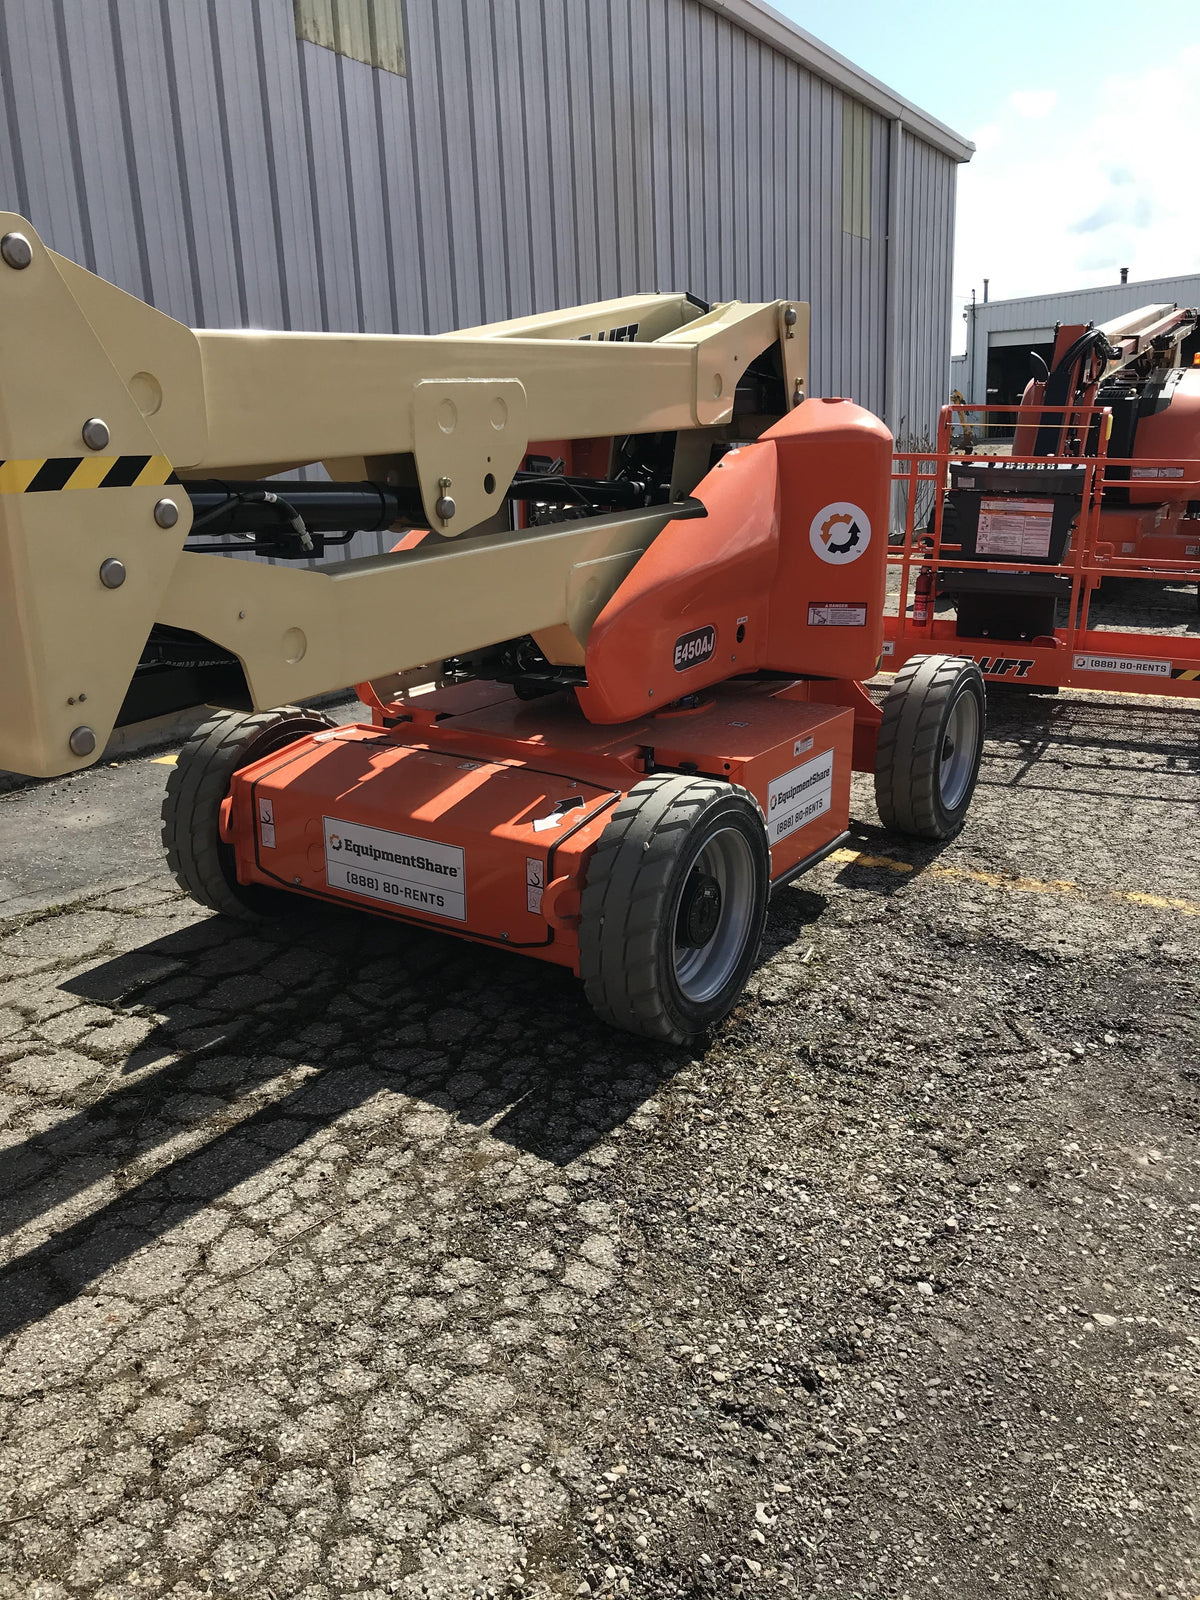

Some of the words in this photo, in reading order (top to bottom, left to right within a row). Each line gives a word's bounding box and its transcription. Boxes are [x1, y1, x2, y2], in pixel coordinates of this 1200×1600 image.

[674, 633, 715, 665] E450AJ
[1090, 659, 1117, 669] (888)
[1119, 662, 1167, 673] 80-RENTS
[777, 768, 831, 805] EquipmentShare
[776, 815, 794, 835] (888)
[795, 798, 823, 823] 80-RENTS
[343, 838, 458, 877] EquipmentShare
[346, 871, 379, 891] (888)
[383, 881, 445, 907] 80-RENTS
